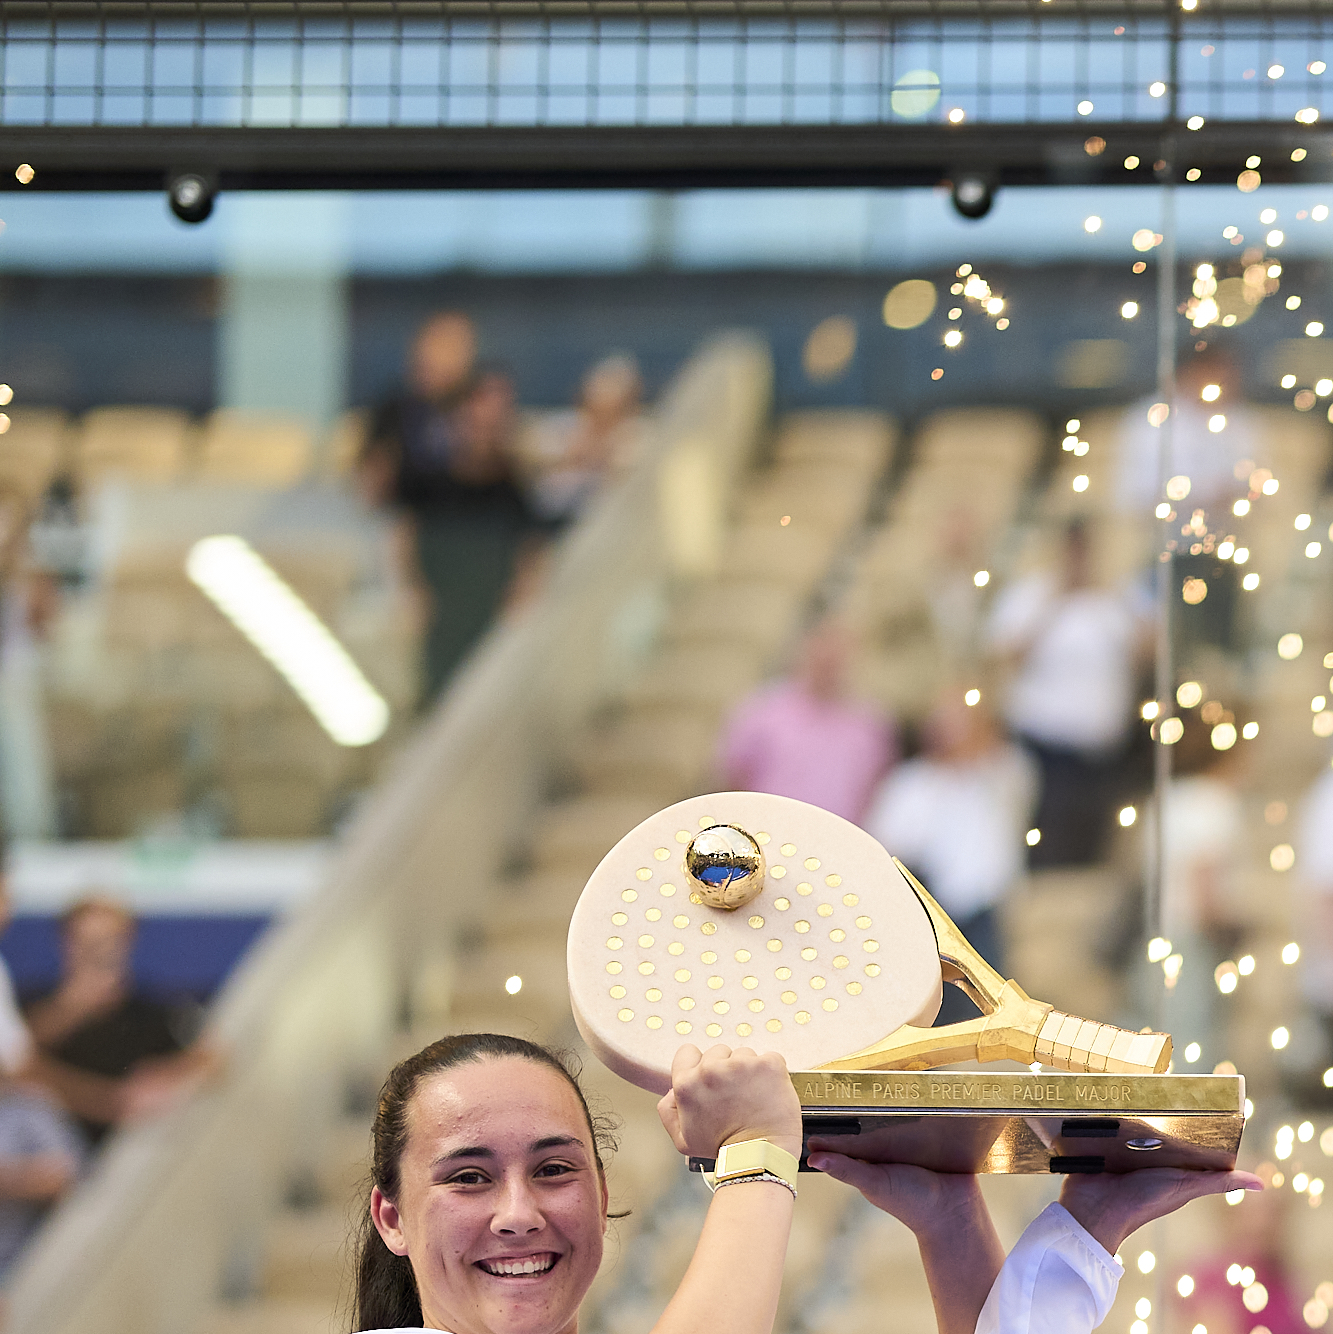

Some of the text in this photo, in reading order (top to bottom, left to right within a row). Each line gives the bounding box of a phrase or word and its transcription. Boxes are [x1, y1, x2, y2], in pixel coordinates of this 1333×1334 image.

[803, 1081, 1132, 1102] ALPINE PARIS PREMIER PADEL MAJOR
